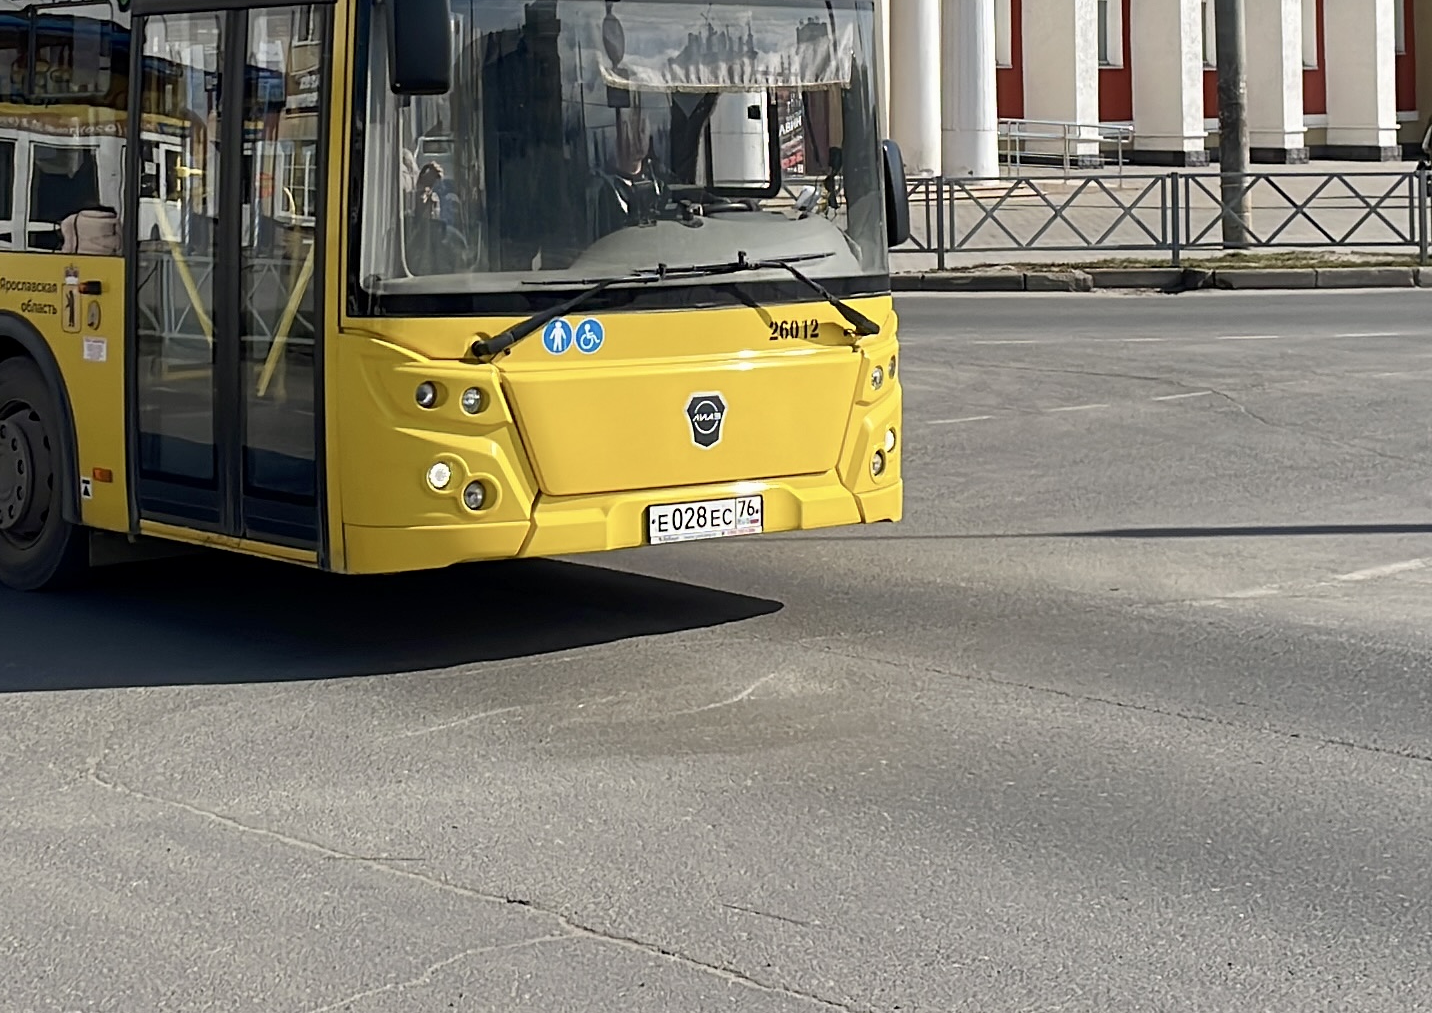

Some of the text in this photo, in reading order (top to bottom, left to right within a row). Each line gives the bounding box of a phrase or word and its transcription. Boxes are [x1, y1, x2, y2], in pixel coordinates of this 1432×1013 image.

[0, 277, 58, 295] Ярославская
[20, 299, 58, 315] область
[769, 318, 820, 341] 26012
[658, 499, 756, 532] Е028ЕС 76
